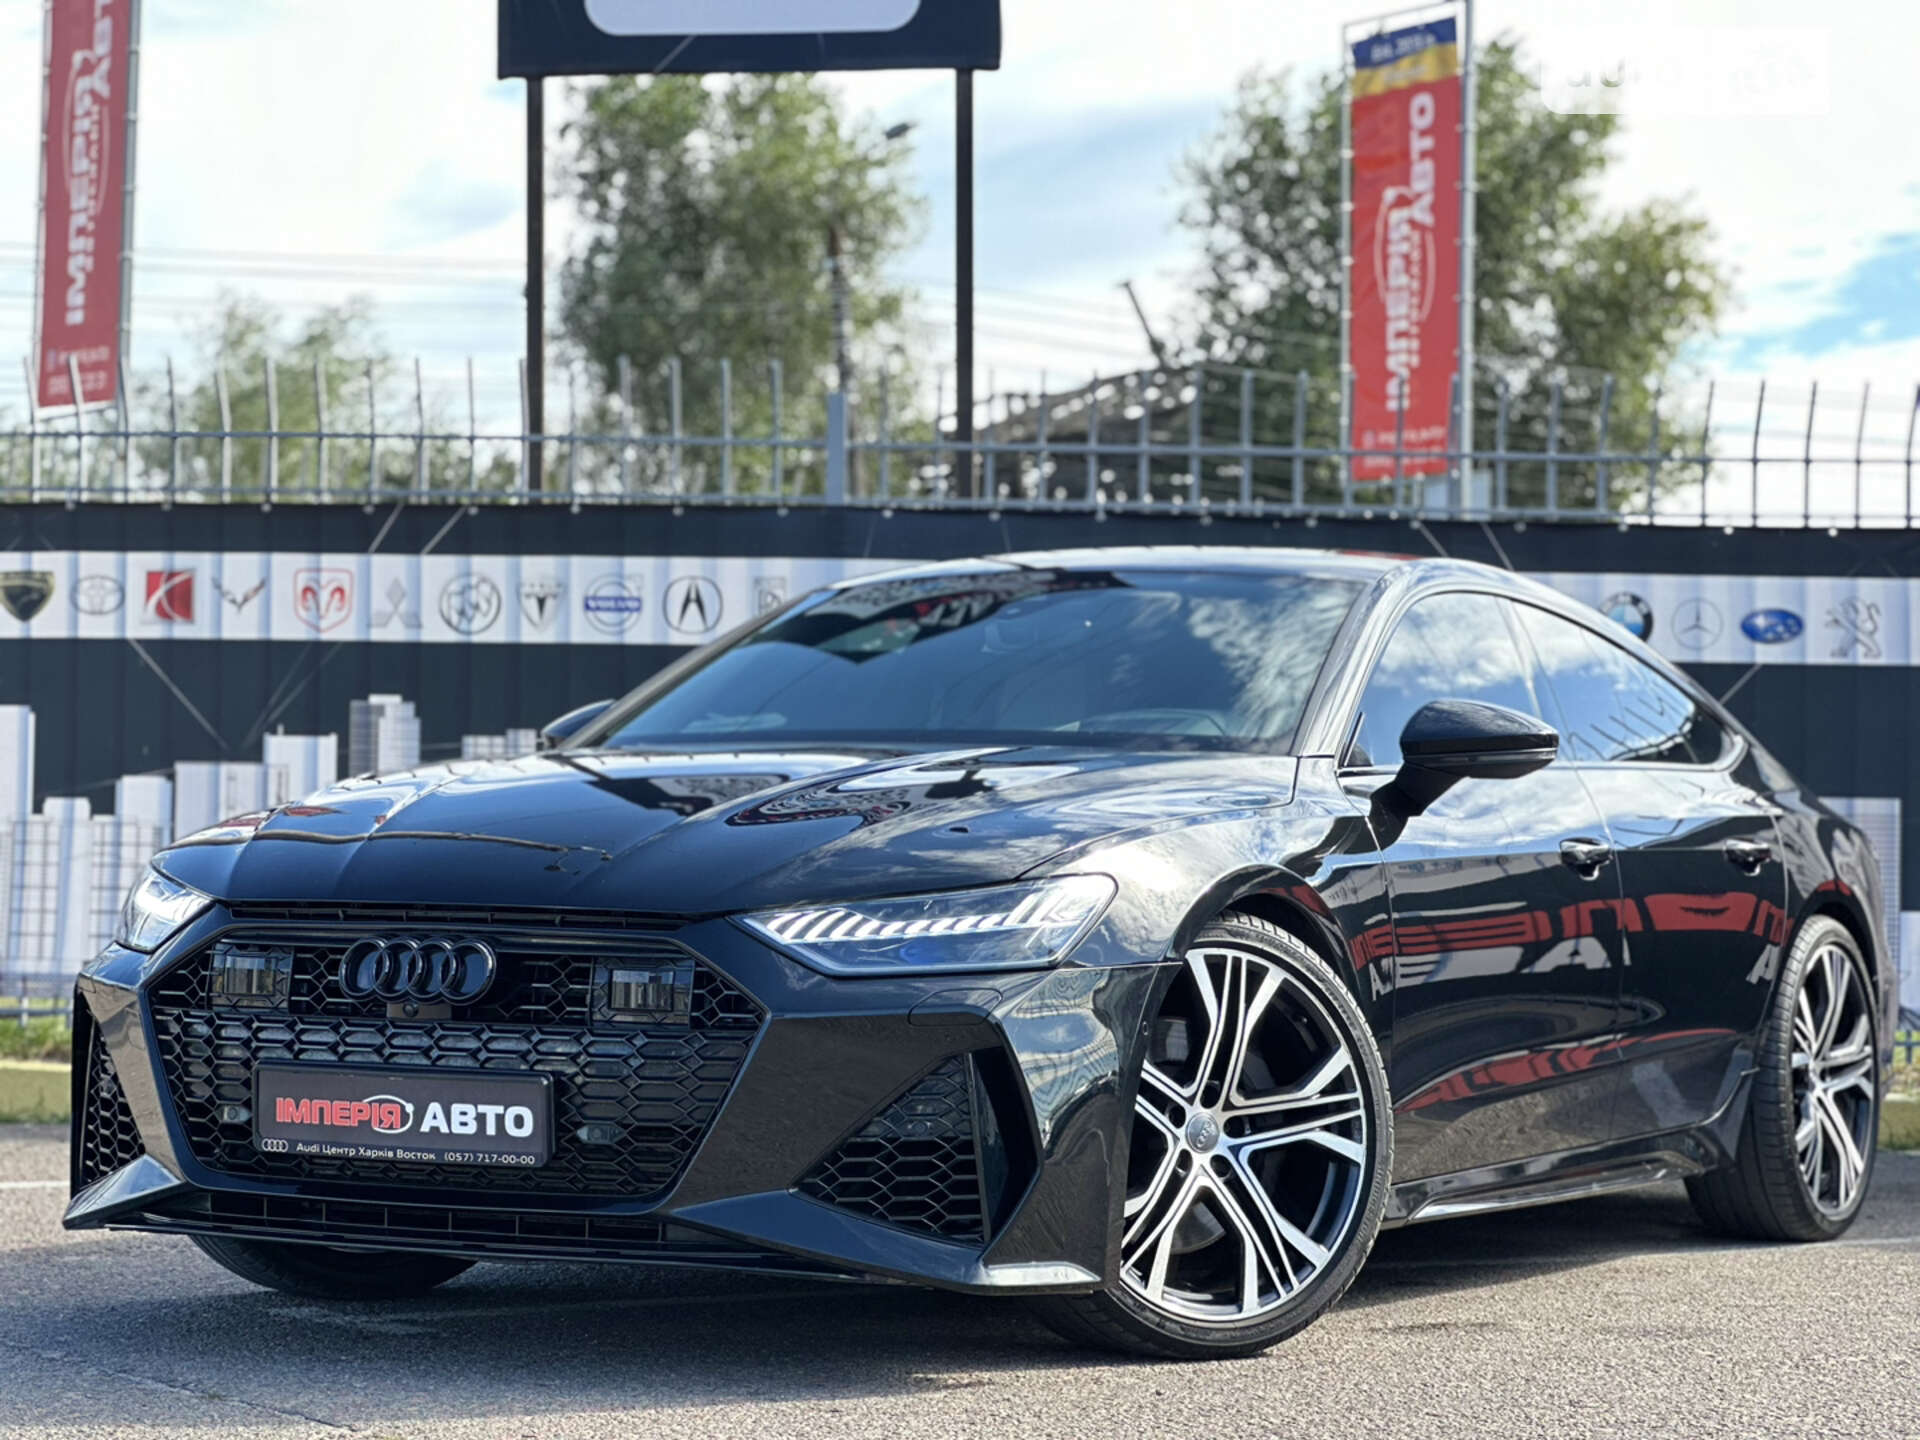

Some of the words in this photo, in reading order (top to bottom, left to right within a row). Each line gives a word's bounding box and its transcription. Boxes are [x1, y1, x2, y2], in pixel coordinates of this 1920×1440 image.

[1410, 91, 1435, 226] АВТО
[275, 1097, 401, 1129] ІМПЕРІЯ
[420, 1102, 534, 1138] АВТО
[296, 1143, 320, 1154] Audi
[322, 1144, 356, 1157] Центр
[358, 1146, 394, 1158] Харків
[396, 1148, 437, 1160] Восток
[444, 1151, 474, 1162] (057)
[477, 1153, 535, 1165] 717-00-00
